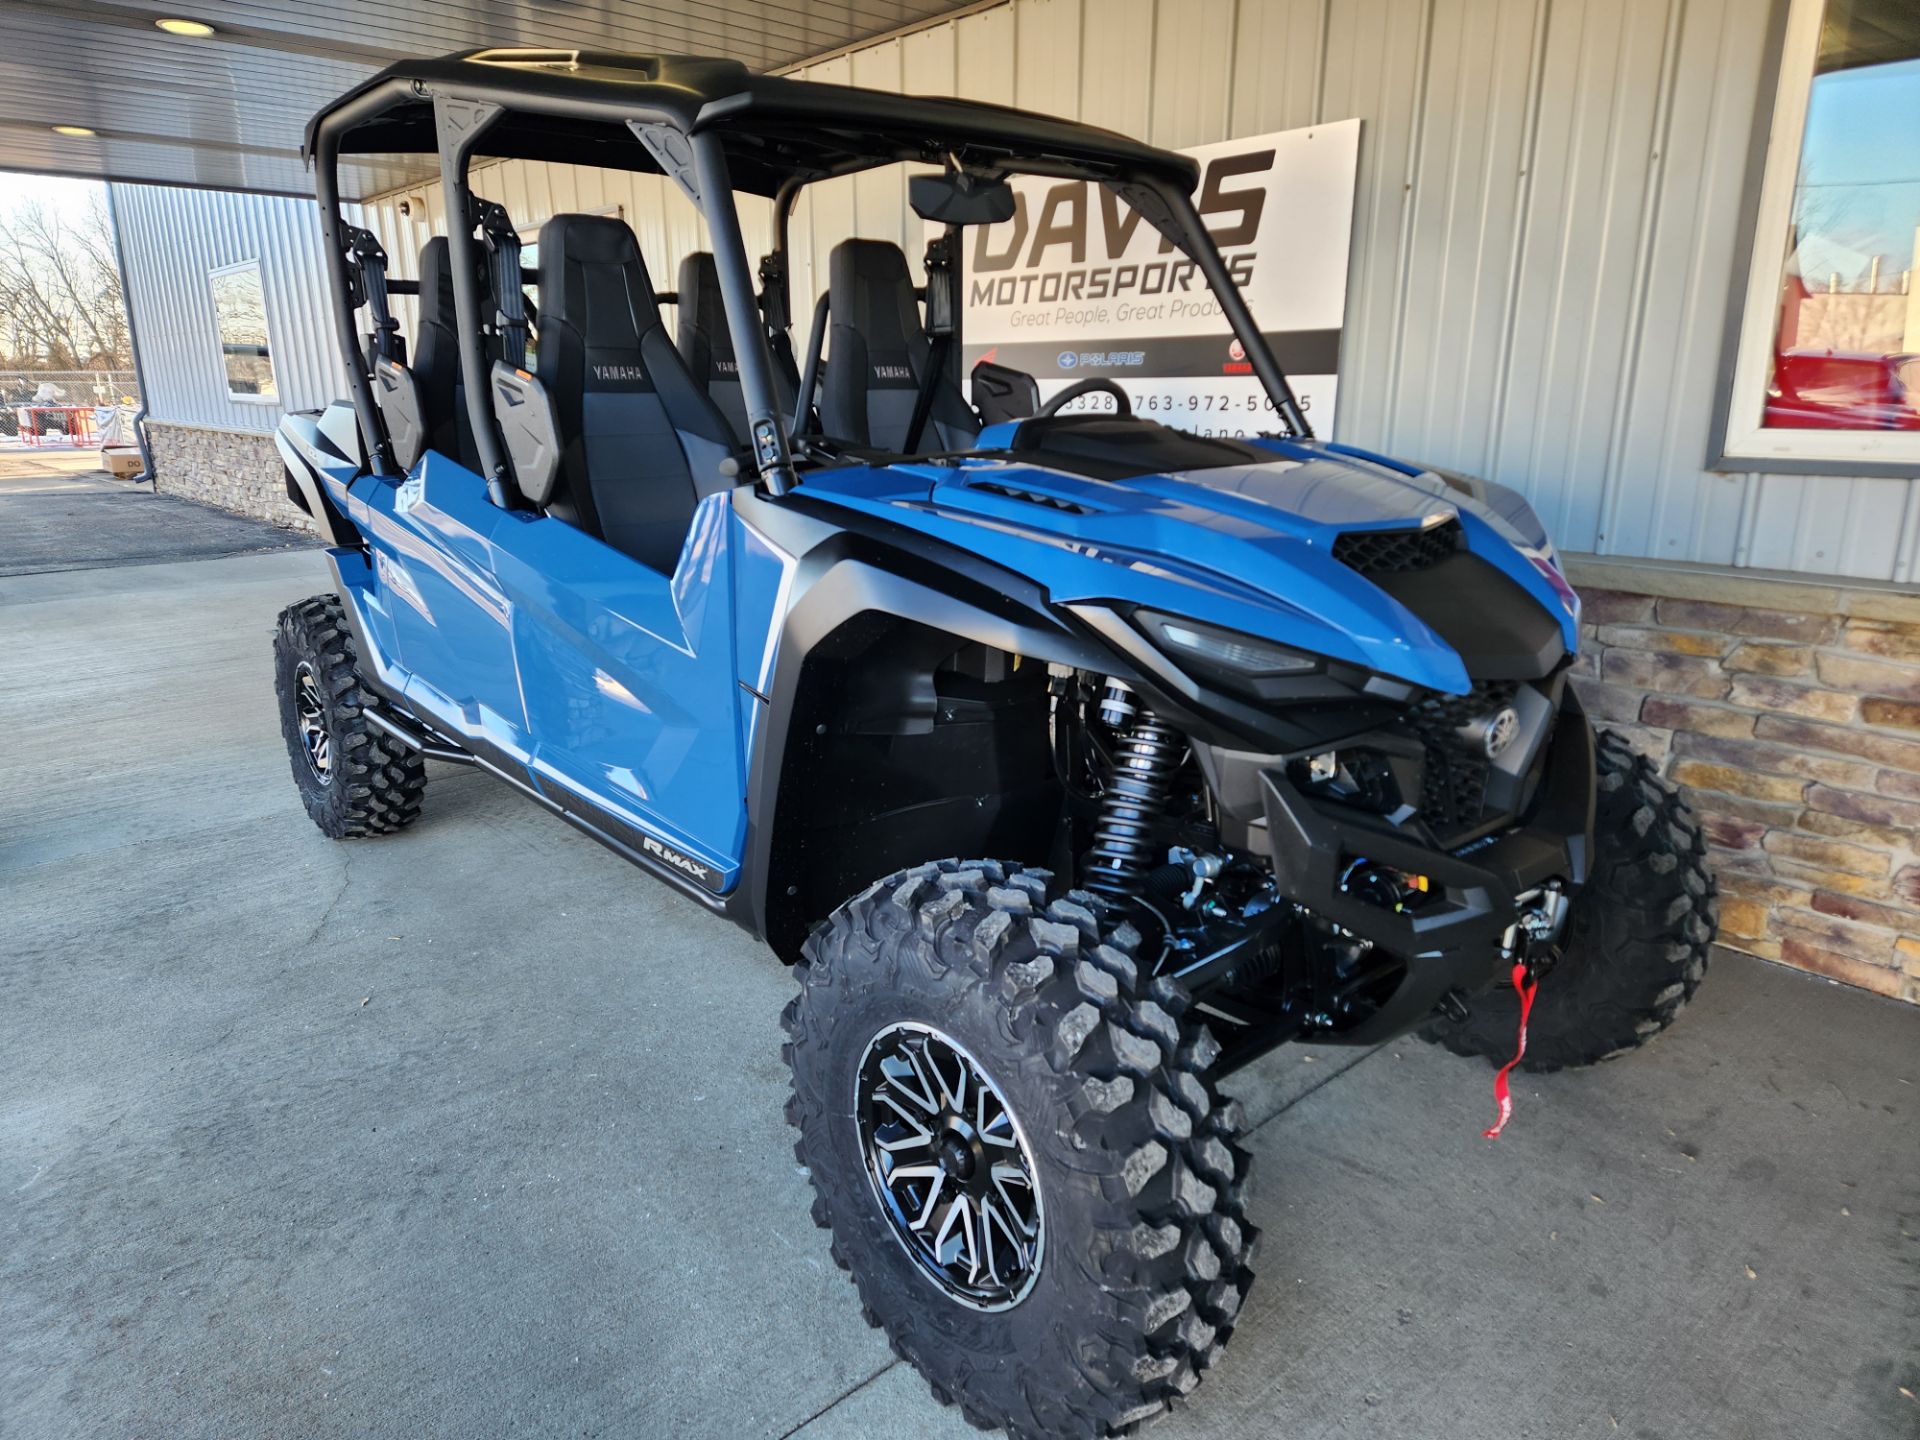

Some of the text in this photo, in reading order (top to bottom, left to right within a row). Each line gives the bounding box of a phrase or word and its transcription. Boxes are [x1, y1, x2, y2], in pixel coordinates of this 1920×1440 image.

[973, 149, 1276, 273] DAVS
[970, 252, 1257, 307] MOTORSPORS
[1010, 298, 1253, 328] Great People, Great Produs
[716, 361, 739, 372] YAMA
[1080, 351, 1145, 367] POLARIS
[593, 366, 642, 380] YAMAHA
[873, 366, 910, 379] YAMAHA
[1135, 395, 1311, 411] 763-972-505
[643, 837, 708, 880] RMAX
